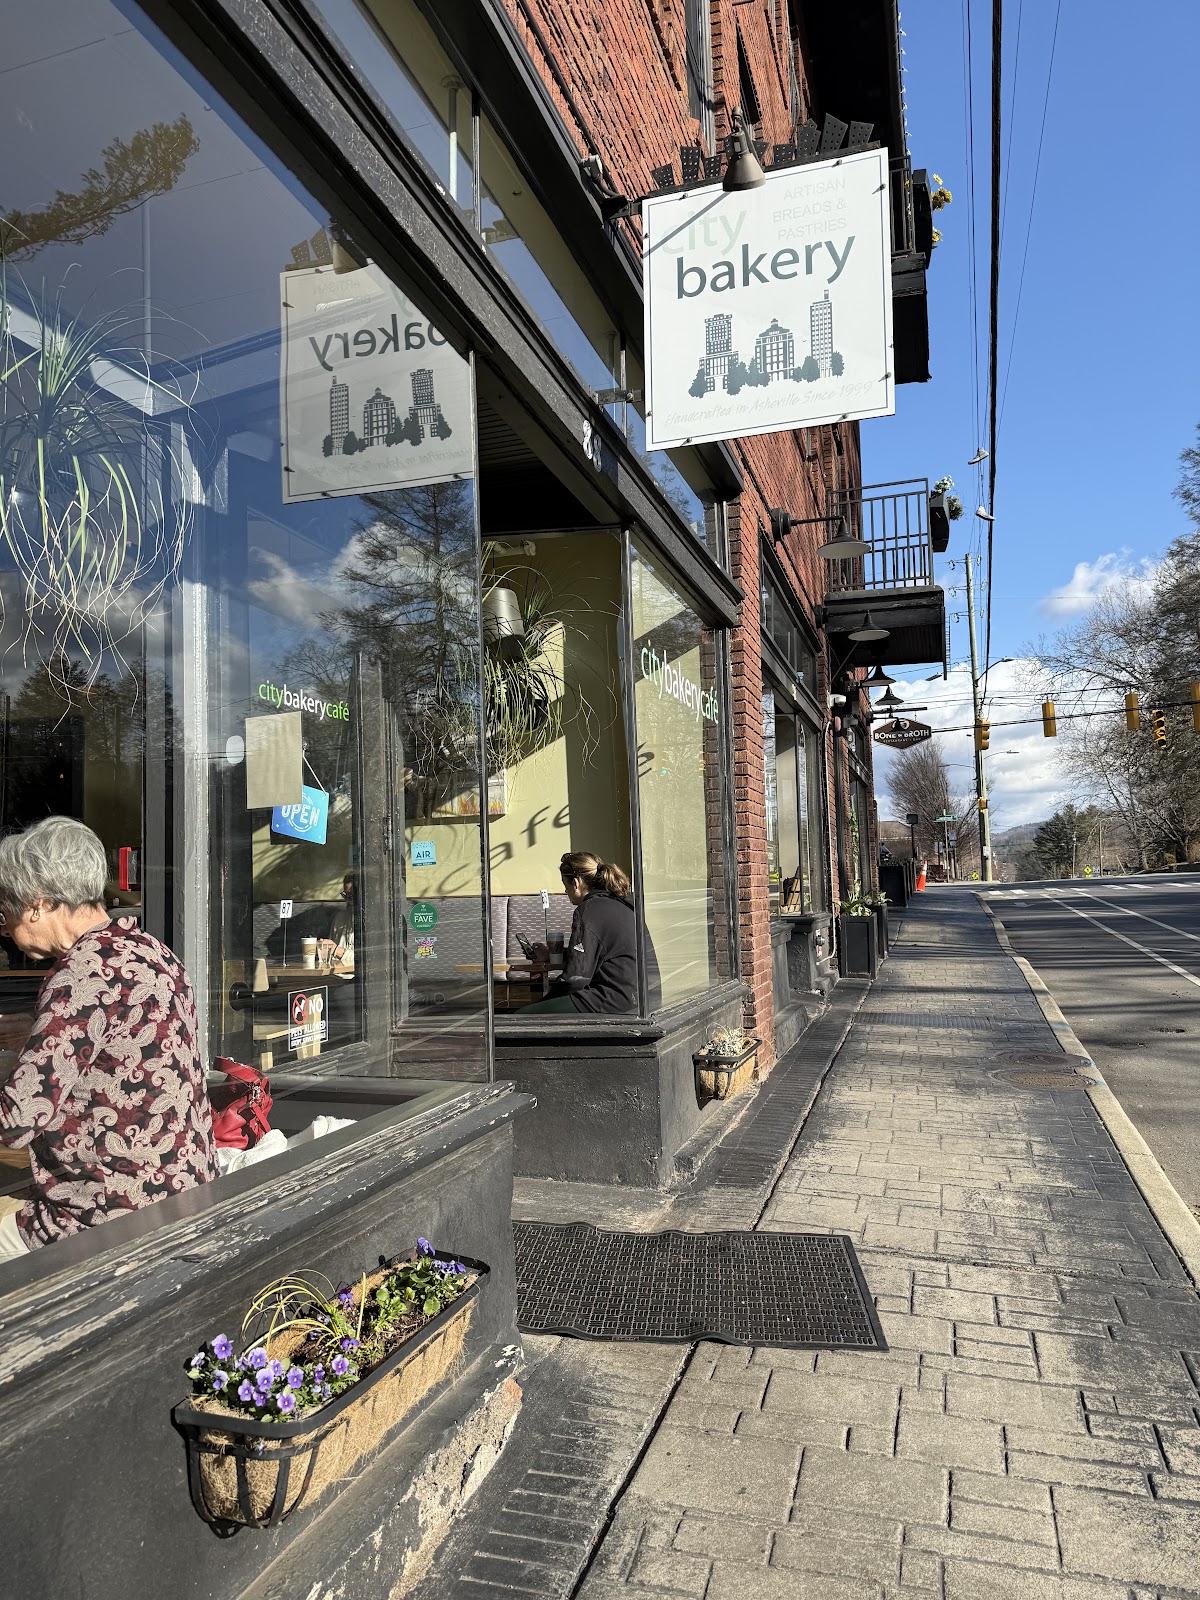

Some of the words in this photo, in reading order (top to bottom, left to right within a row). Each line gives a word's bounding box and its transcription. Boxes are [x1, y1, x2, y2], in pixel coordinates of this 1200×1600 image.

[783, 177, 847, 201] ARTISAN
[772, 200, 831, 223] BREADS
[836, 198, 848, 210] &
[660, 210, 747, 257] city
[777, 216, 848, 242] PASTRIES
[676, 235, 857, 300] bakery
[664, 402, 731, 427] Handcrafted
[736, 403, 748, 416] in
[749, 392, 801, 412] Asheville
[802, 387, 836, 405] Since
[838, 380, 874, 399] 1999
[258, 680, 350, 721] citybakerycafé
[874, 732, 897, 740] BONE
[904, 729, 929, 738] BROTH
[281, 803, 321, 827] OPEN
[416, 850, 431, 859] AIR
[281, 902, 291, 914] 87
[414, 915, 433, 923] FAVE
[308, 997, 324, 1015] NO
